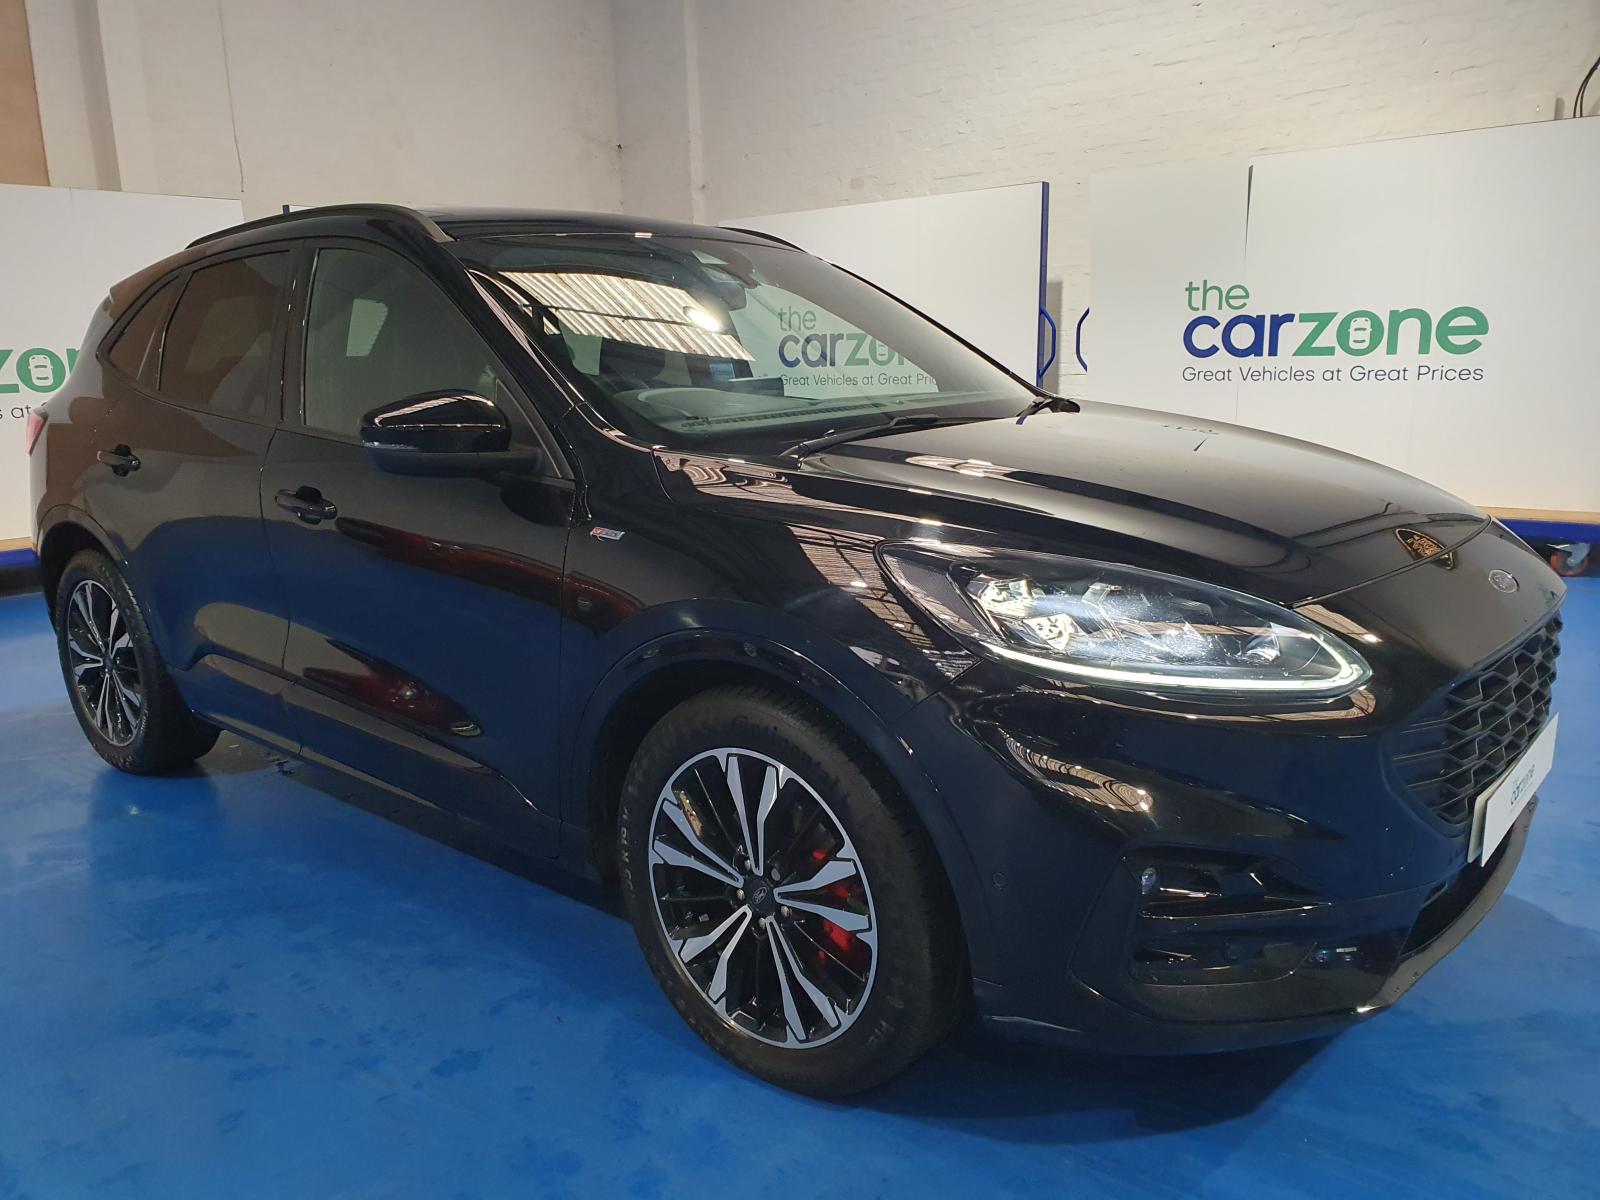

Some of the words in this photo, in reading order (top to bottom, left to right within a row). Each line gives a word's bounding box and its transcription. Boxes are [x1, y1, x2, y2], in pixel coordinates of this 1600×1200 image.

[1185, 279, 1250, 311] the
[778, 306, 817, 332] the
[1182, 306, 1490, 359] carzone
[778, 332, 905, 368] carzo
[780, 373, 810, 387] Great
[813, 373, 858, 387] Vehicles
[861, 374, 874, 386] at
[878, 372, 912, 385] Great
[1182, 366, 1232, 382] Great
[1239, 365, 1315, 382] Vehicles
[1322, 367, 1342, 382] at
[1349, 365, 1409, 382] Great
[1417, 364, 1485, 382] Prices
